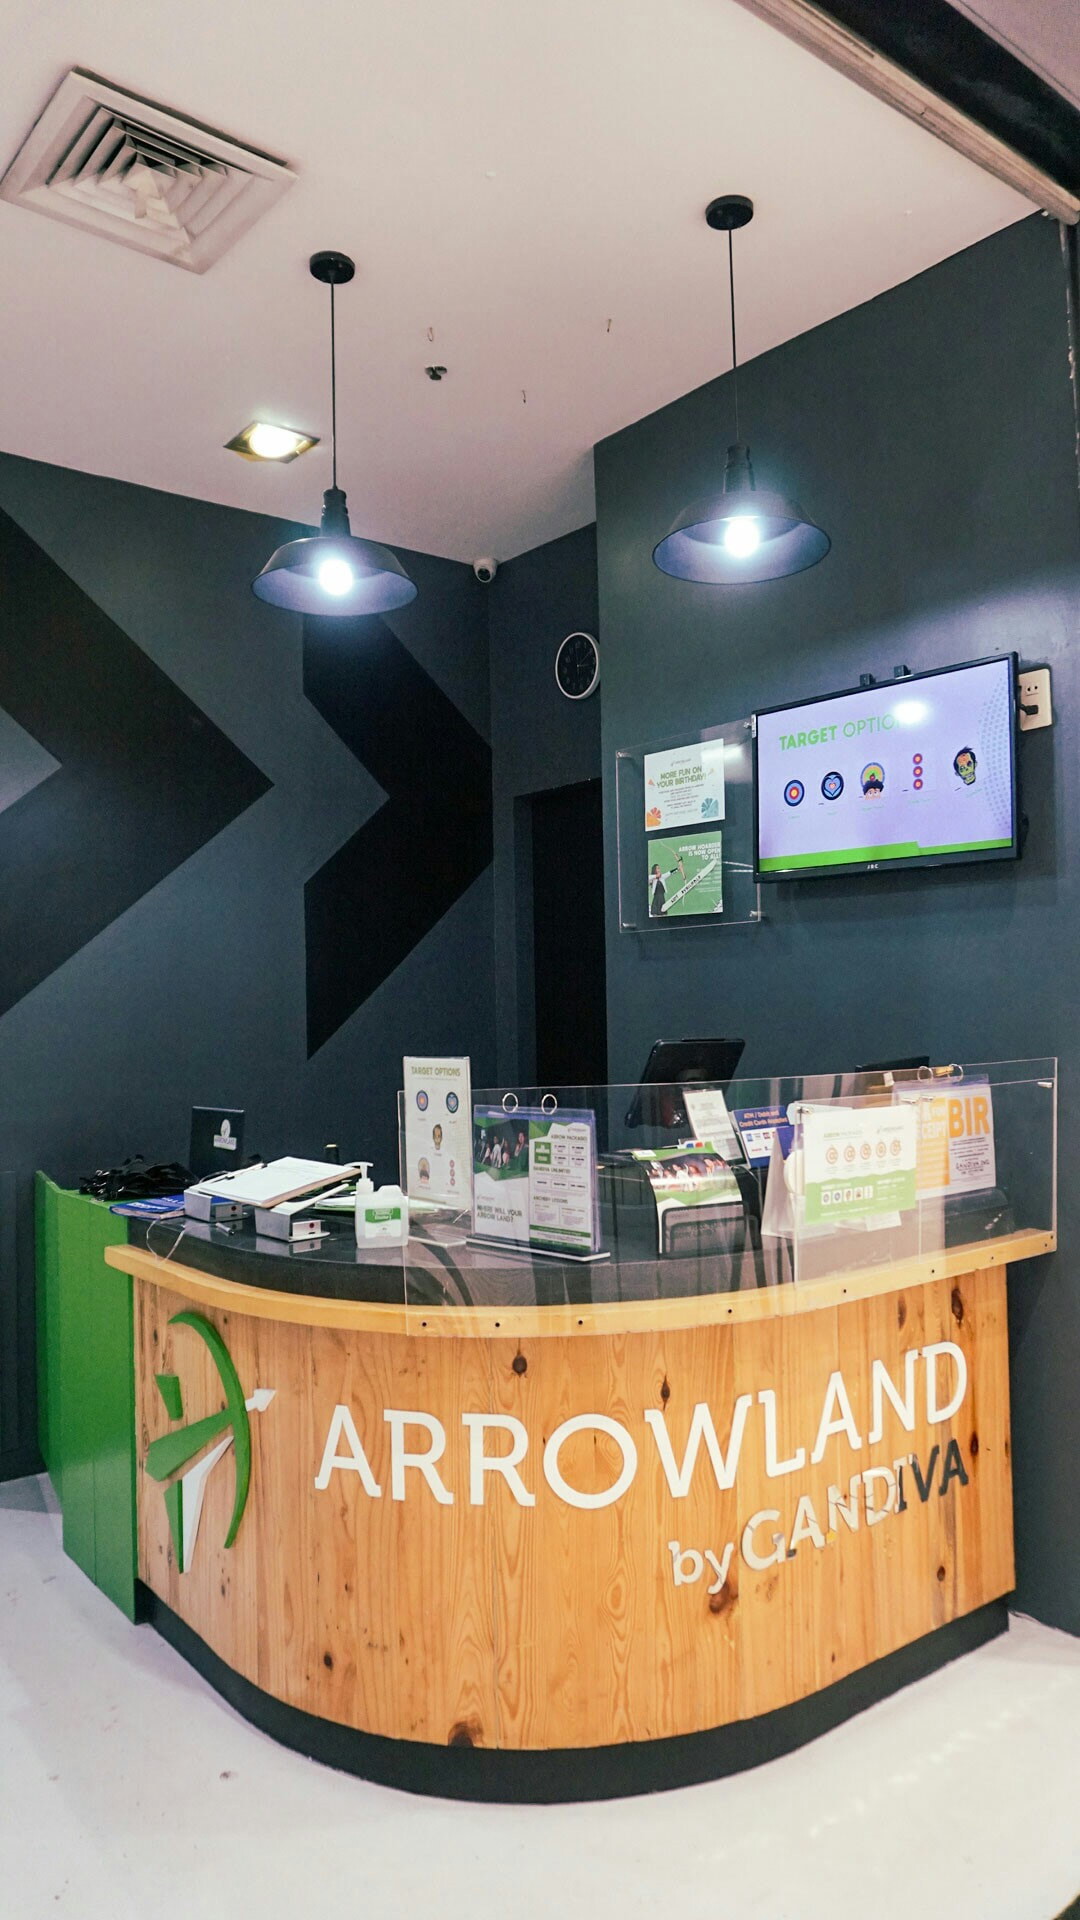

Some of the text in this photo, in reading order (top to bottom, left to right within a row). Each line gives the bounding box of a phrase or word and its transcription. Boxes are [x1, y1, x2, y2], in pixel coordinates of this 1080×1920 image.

[779, 713, 900, 751] TARGET OPTIO
[660, 765, 702, 780] MORE FUN ON
[657, 779, 674, 789] YOUR
[675, 773, 706, 785] BIRTHDAY!
[678, 844, 697, 852] ARROW
[411, 1066, 461, 1076] TARGET OPTIONS
[947, 1096, 990, 1138] BIR
[477, 1211, 495, 1219] ARROW
[314, 1341, 968, 1510] ARROWLAND
[668, 1438, 969, 1595] by GANDIVA
